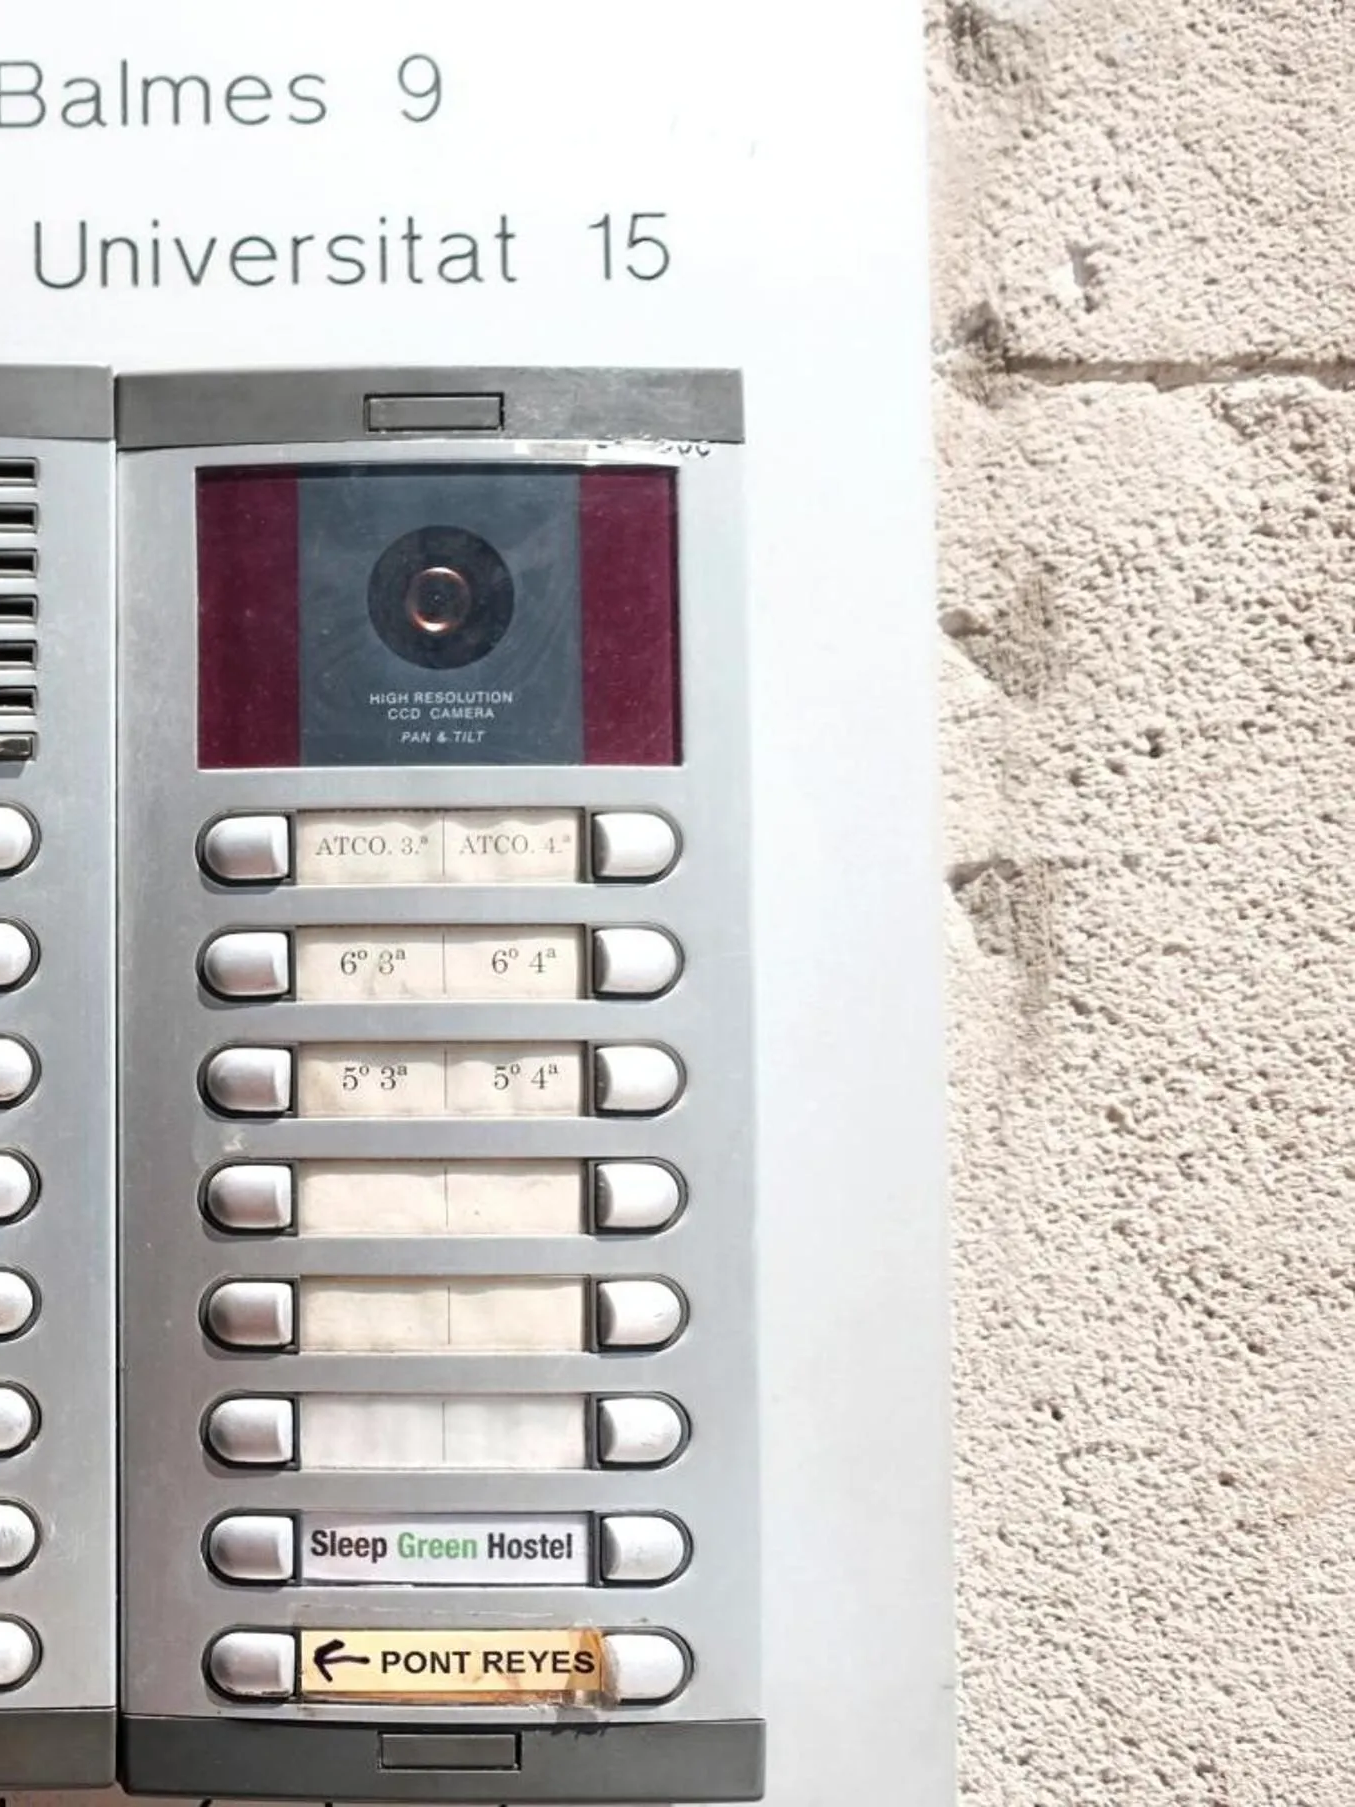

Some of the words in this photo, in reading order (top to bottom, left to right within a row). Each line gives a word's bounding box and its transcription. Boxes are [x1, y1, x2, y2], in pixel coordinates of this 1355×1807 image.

[396, 54, 446, 125] 9
[31, 214, 518, 290] Universitat
[590, 211, 672, 283] 15
[370, 692, 409, 705] HIGH
[414, 691, 513, 704] RESOLUTION
[388, 708, 421, 720] CCD
[430, 707, 495, 720] CAMERA
[400, 731, 431, 743] PAN
[437, 731, 446, 743] &
[453, 730, 487, 743] TILT
[316, 836, 393, 855] ATCO.
[459, 834, 535, 854] ATCO.
[310, 1529, 388, 1562] Sleep
[397, 1532, 478, 1560] Green
[487, 1533, 573, 1560] Hostel
[381, 1651, 471, 1674] PONT
[483, 1651, 595, 1674] REYES
